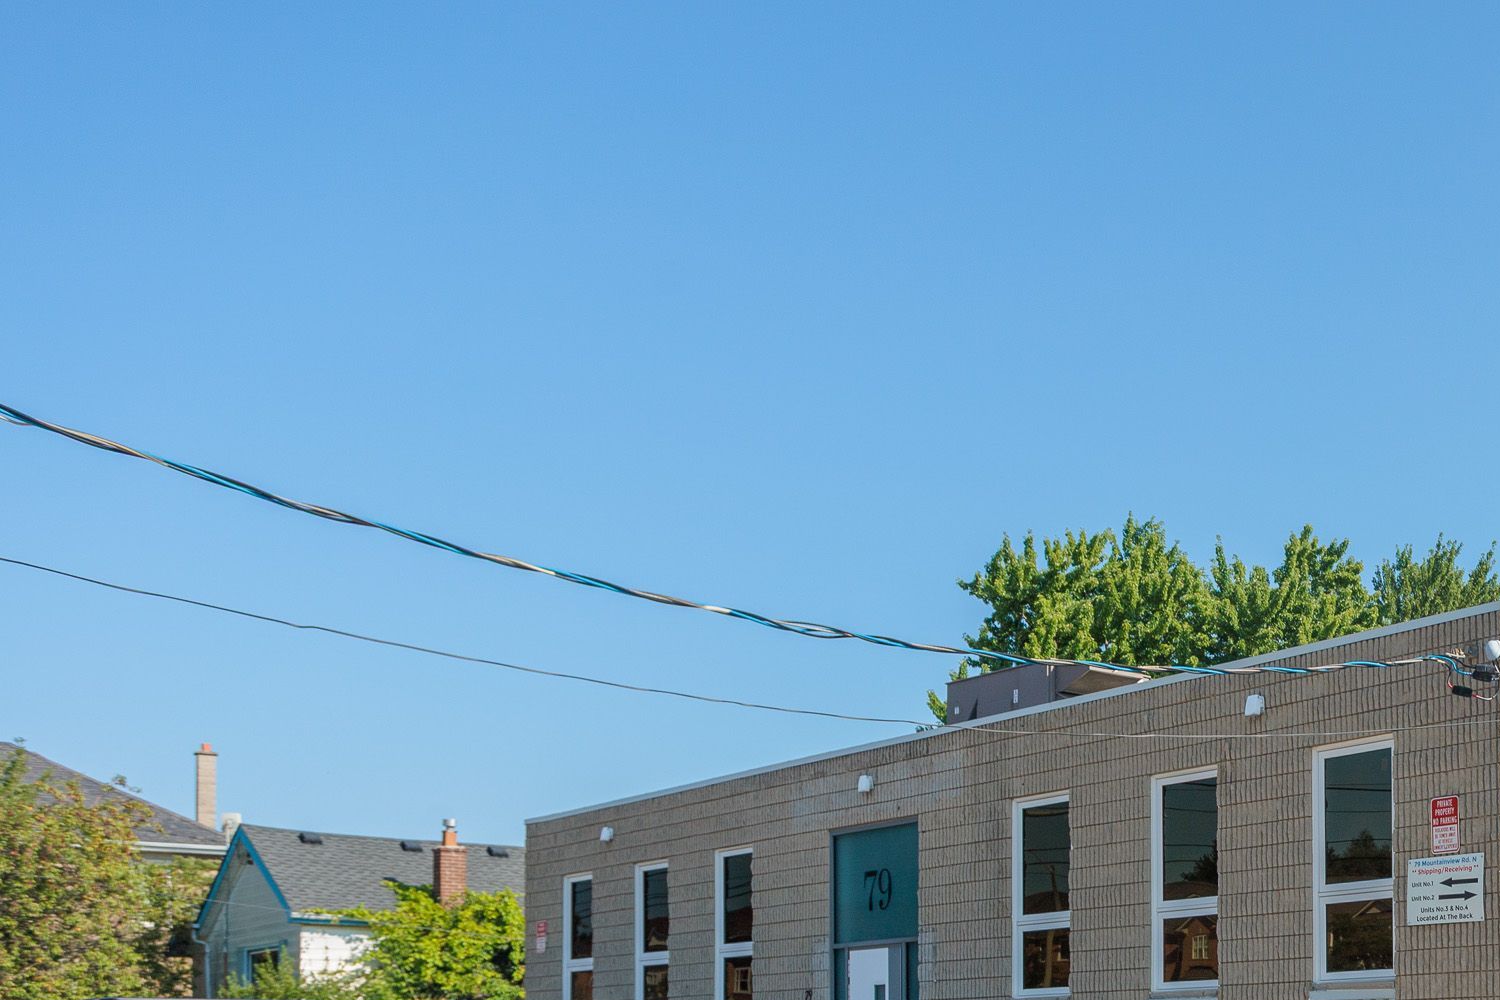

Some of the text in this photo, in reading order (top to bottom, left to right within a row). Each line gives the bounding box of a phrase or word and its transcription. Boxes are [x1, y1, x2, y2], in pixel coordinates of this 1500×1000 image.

[1436, 799, 1452, 808] PRIVATE
[1434, 807, 1455, 816] PROPERTY
[1440, 816, 1457, 824] PARKING
[1421, 858, 1460, 867] Mountainview
[1418, 865, 1472, 875] Shipping/Receiving
[863, 868, 892, 911] 79
